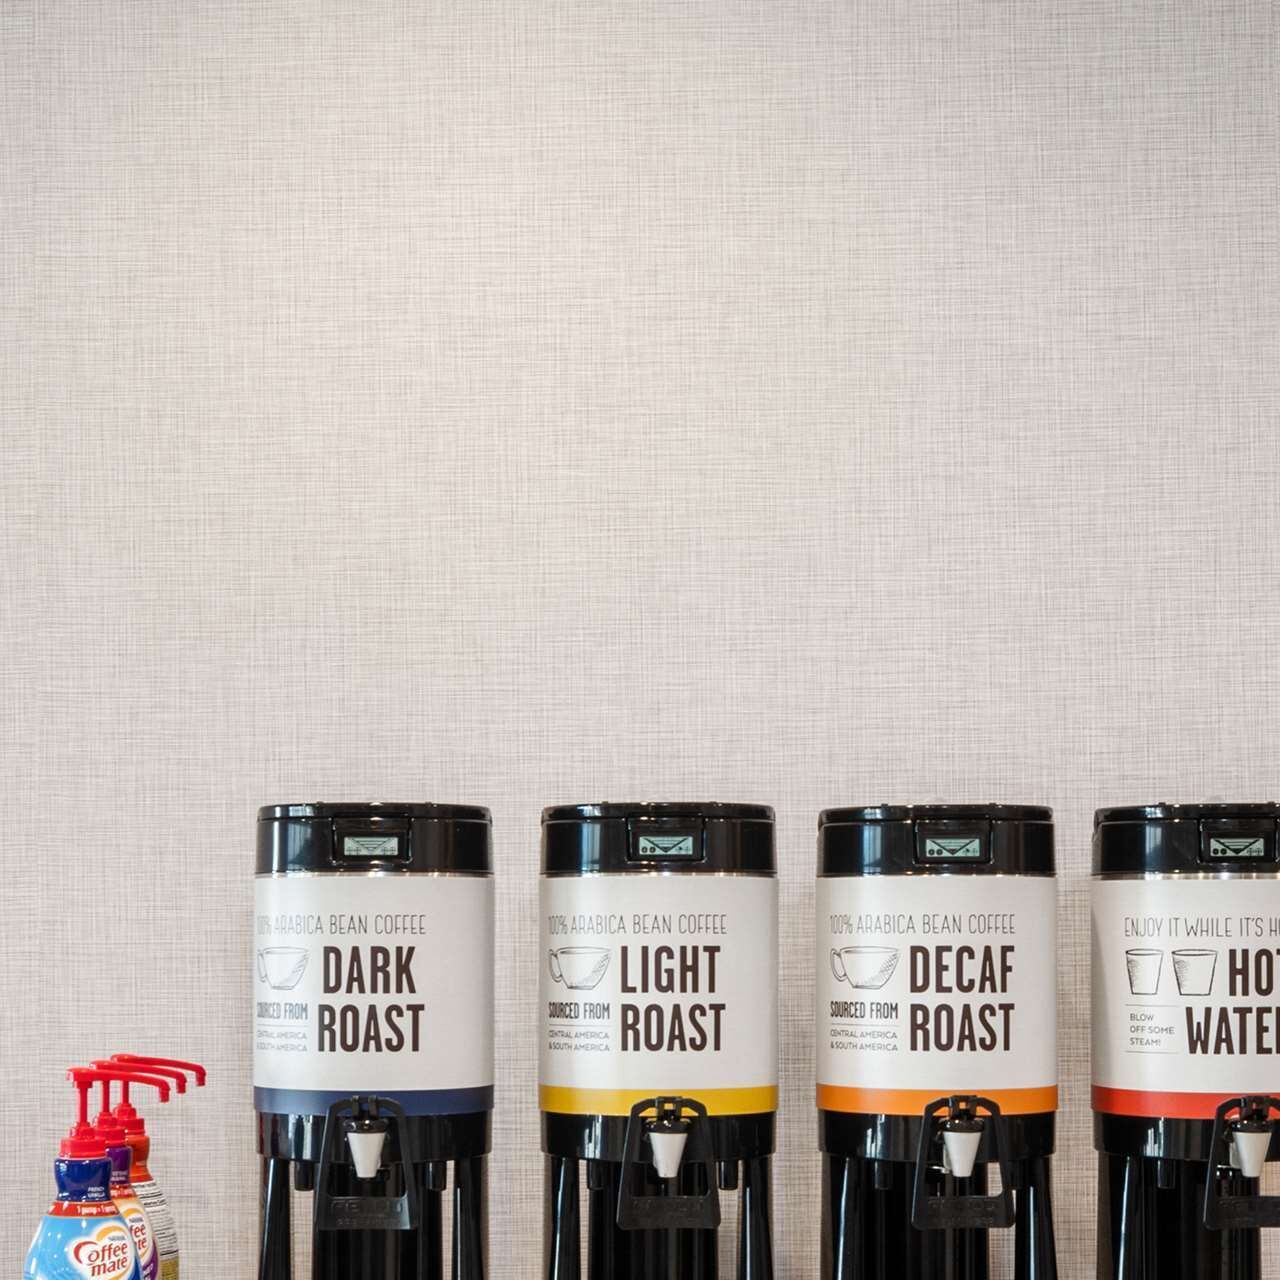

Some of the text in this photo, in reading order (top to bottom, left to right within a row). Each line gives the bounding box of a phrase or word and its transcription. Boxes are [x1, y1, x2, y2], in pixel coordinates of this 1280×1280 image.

[274, 914, 324, 935] ARABICA
[329, 914, 369, 935] BEAN
[374, 914, 427, 935] COFFEE
[548, 914, 728, 935] 100% ARABICA BEAN COFFEE
[830, 914, 1016, 935] 100% ARABICA BEAN COFFEE
[1124, 917, 1164, 938] ENJOY
[1168, 917, 1181, 938] IT
[1183, 917, 1233, 938] WHILE
[1239, 917, 1264, 938] IT'S
[323, 946, 417, 994] DARK
[620, 945, 721, 993] LIGHT
[910, 945, 1015, 993] DECAF
[283, 1002, 309, 1020] FROM
[548, 1001, 611, 1020] SOURCED FROM
[830, 1001, 899, 1020] SOURCED FROM
[1129, 1012, 1155, 1022] BLOW
[318, 1003, 425, 1053] ROAST
[573, 1030, 610, 1041] AMERICA
[620, 1003, 727, 1052] ROAST
[860, 1030, 899, 1040] AMERICA
[910, 1003, 1016, 1052] ROAST
[1129, 1026, 1175, 1035] OFF SOME
[572, 1043, 611, 1052] AMERICA
[835, 1041, 858, 1051] SOUTH
[859, 1042, 899, 1052] AMERICA
[1129, 1037, 1162, 1047] STEAM!
[73, 1241, 128, 1265] Coffee
[90, 1256, 128, 1277] mate
